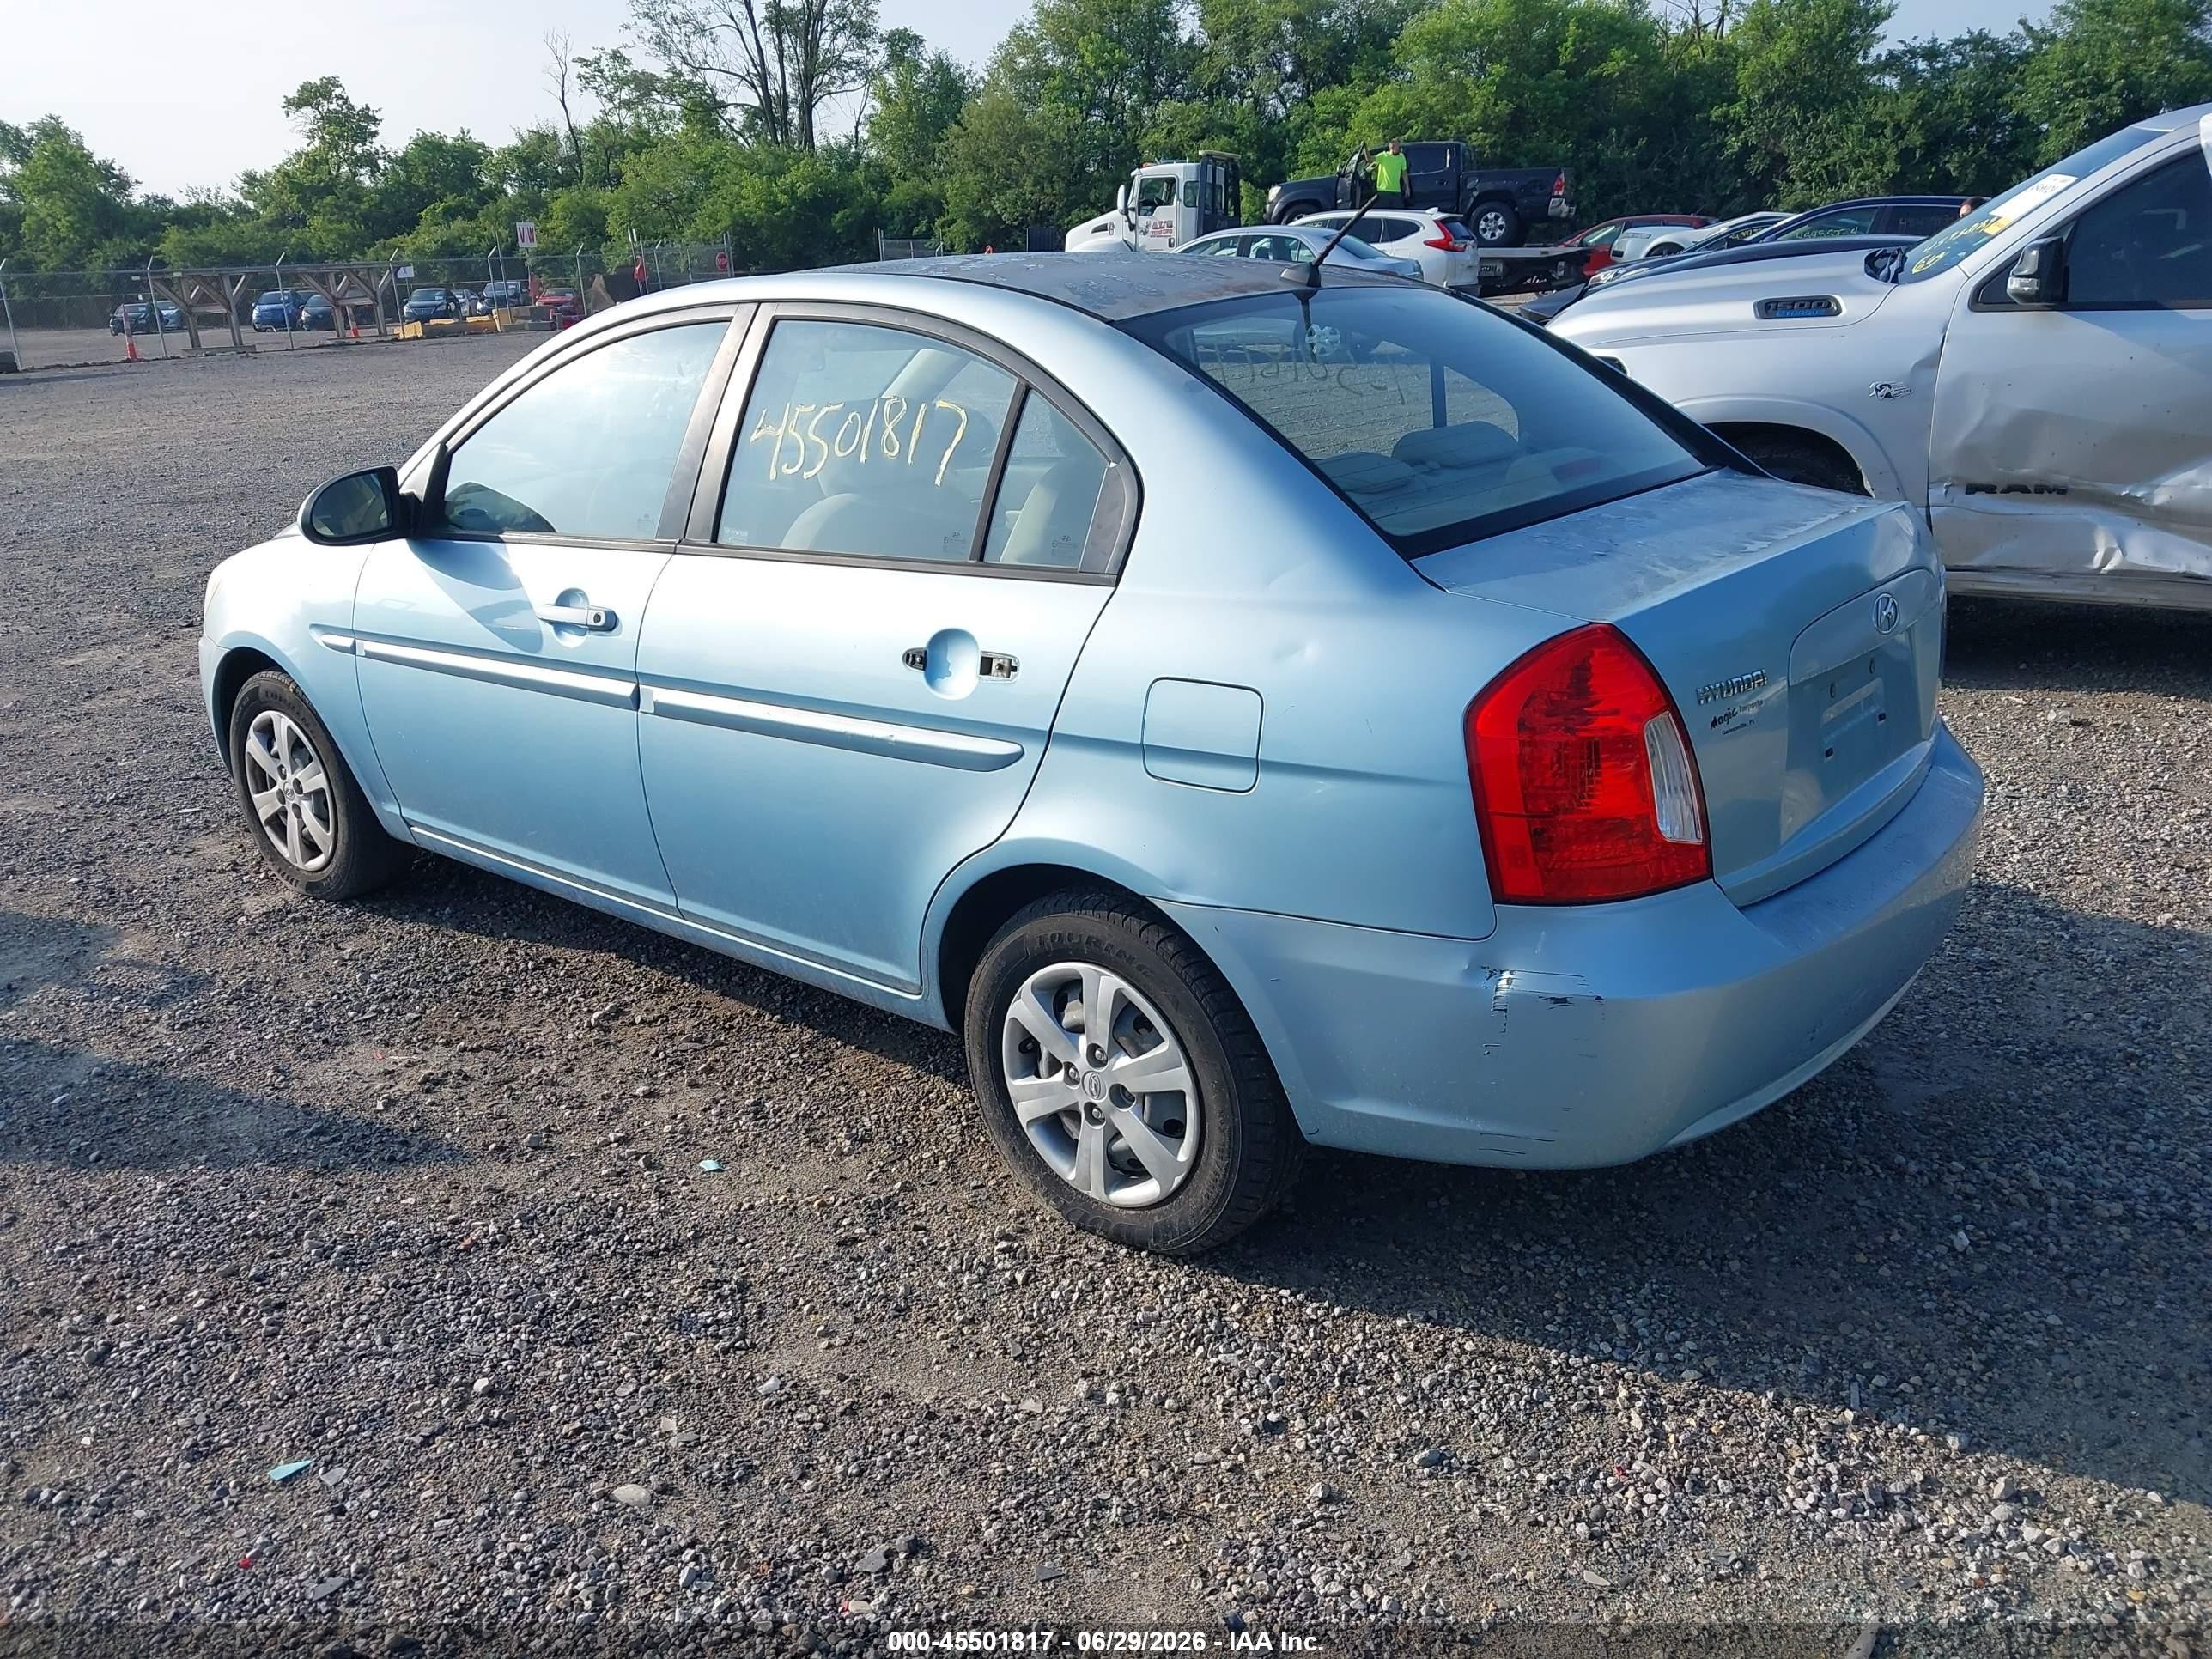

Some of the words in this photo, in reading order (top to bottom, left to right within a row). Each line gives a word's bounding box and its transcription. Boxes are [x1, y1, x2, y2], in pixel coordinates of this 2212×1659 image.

[1769, 301, 1828, 310] 1500
[749, 395, 968, 487] 45501817
[1965, 483, 2069, 495] RAM
[1696, 669, 1768, 705] HYUNDAI
[1710, 707, 1739, 731] Magic
